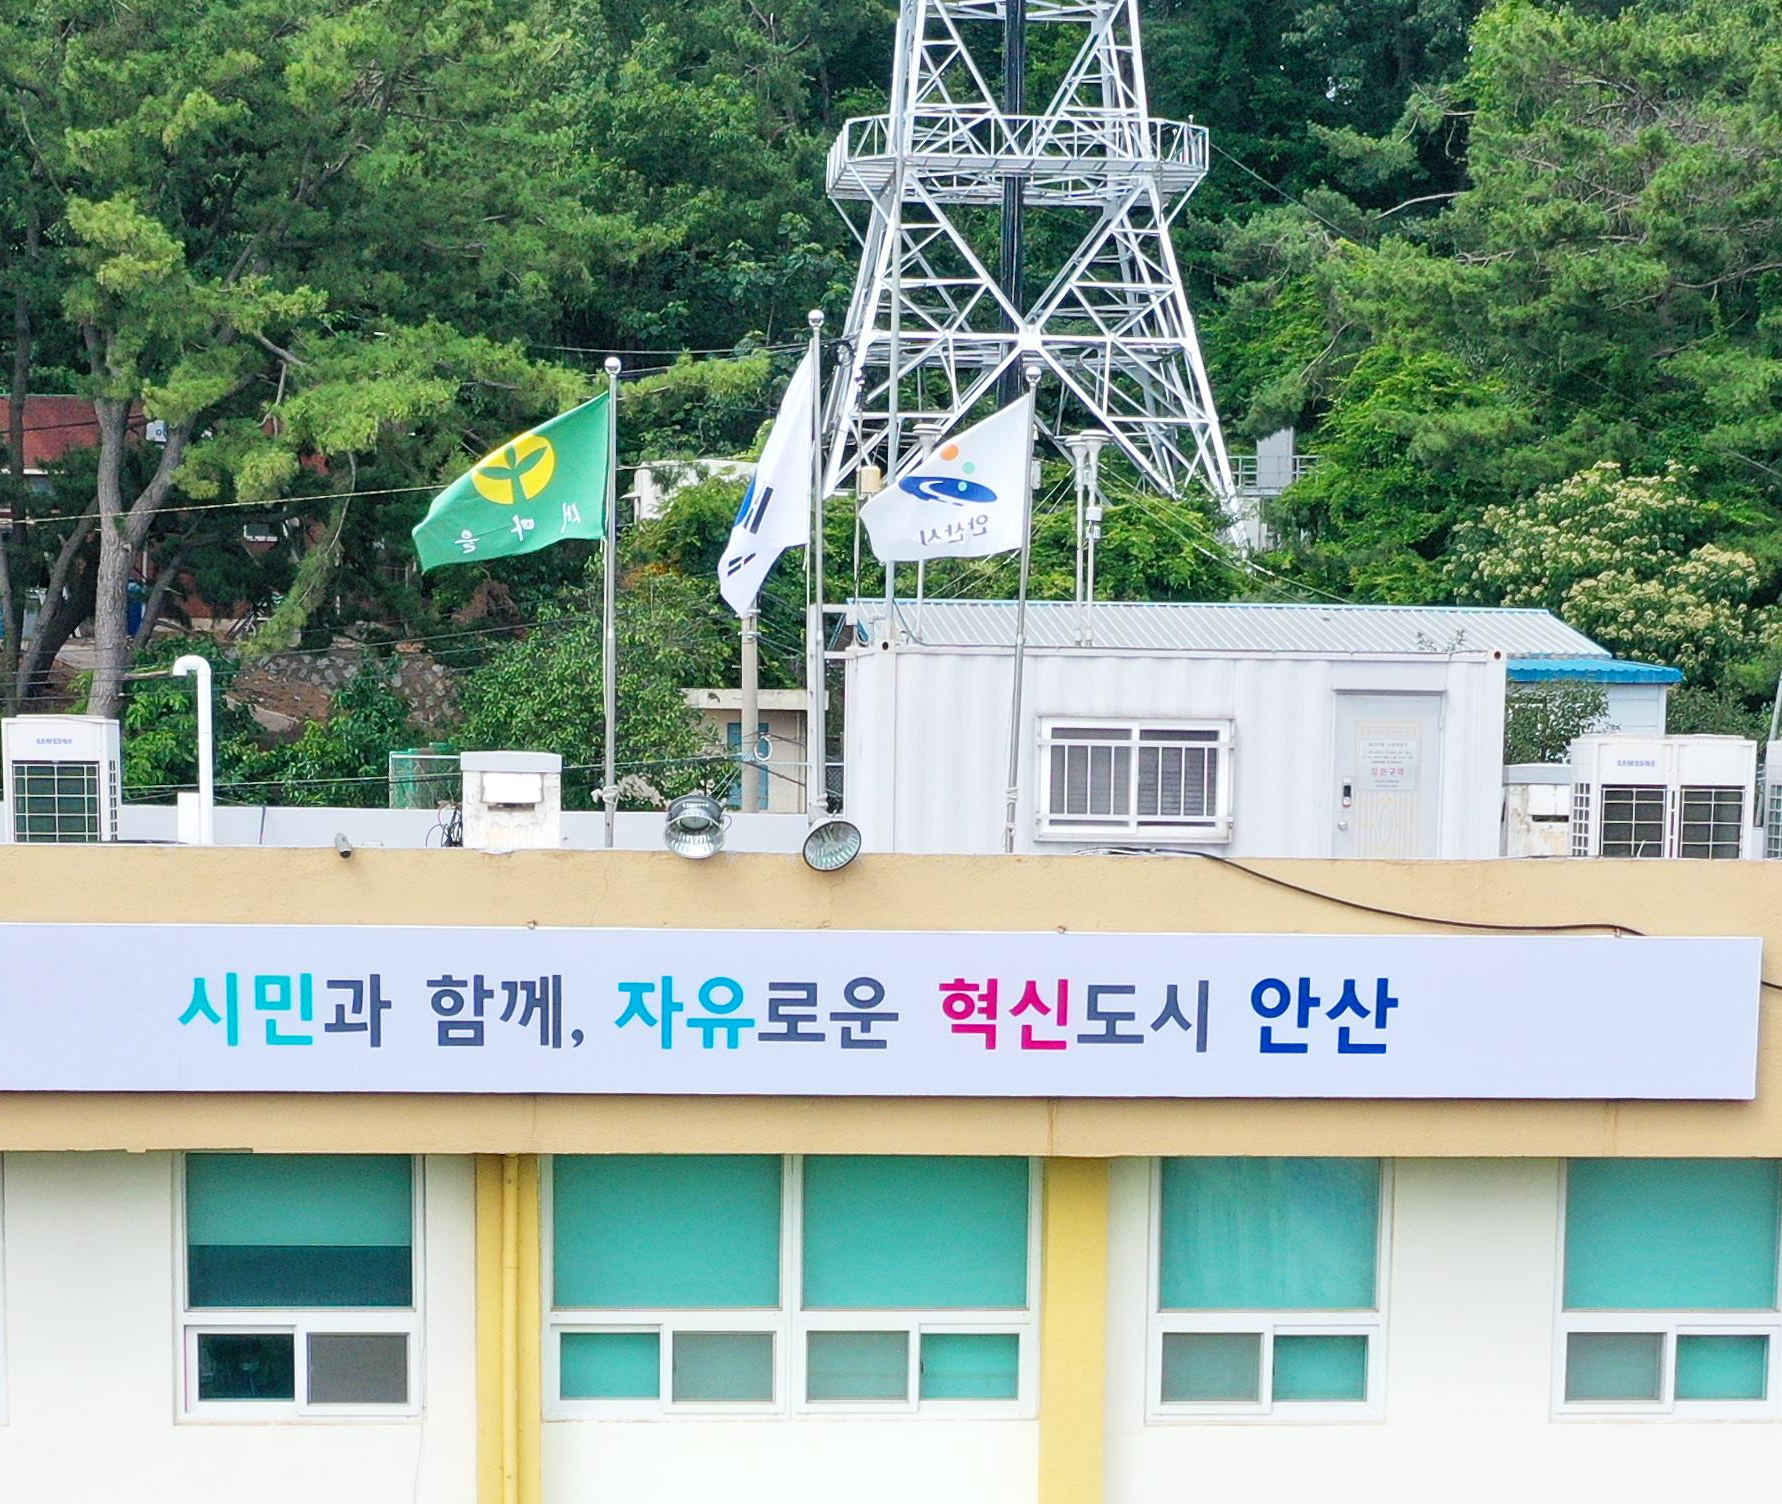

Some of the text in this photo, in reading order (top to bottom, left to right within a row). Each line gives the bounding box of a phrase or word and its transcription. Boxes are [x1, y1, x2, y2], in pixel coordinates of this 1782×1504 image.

[177, 971, 1400, 1055] 시민과 함께, 자유로운 혁신도시 안산
